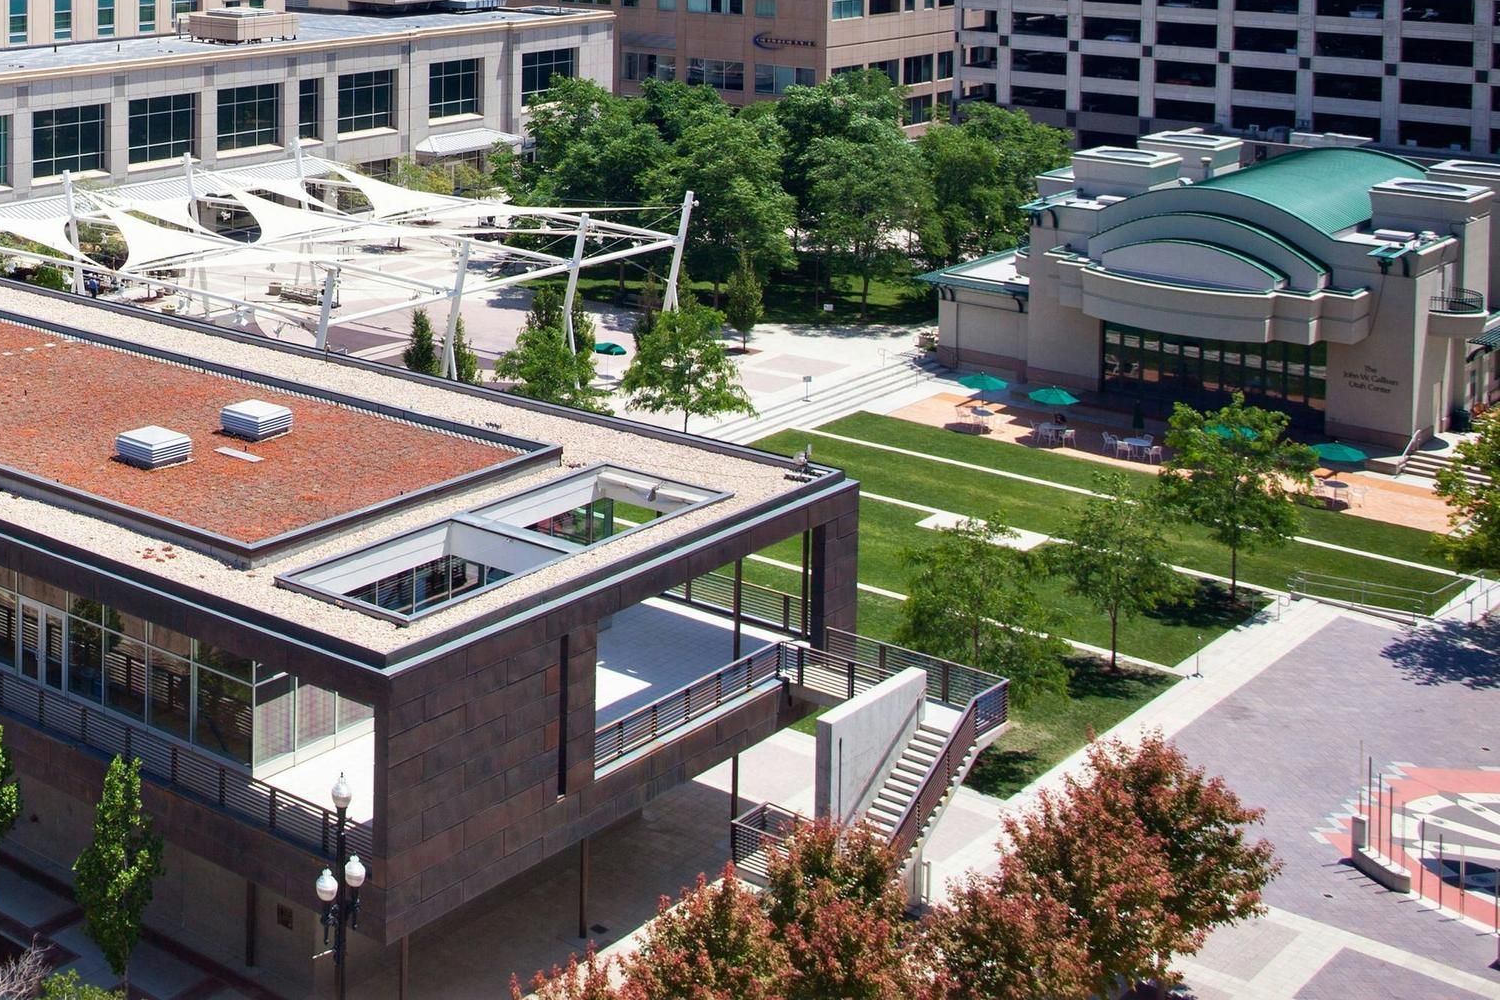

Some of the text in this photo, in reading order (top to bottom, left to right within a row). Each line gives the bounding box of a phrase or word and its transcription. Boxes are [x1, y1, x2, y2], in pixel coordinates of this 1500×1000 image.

[1364, 364, 1378, 373] The
[1343, 371, 1360, 379] John
[1367, 384, 1391, 394] Center
